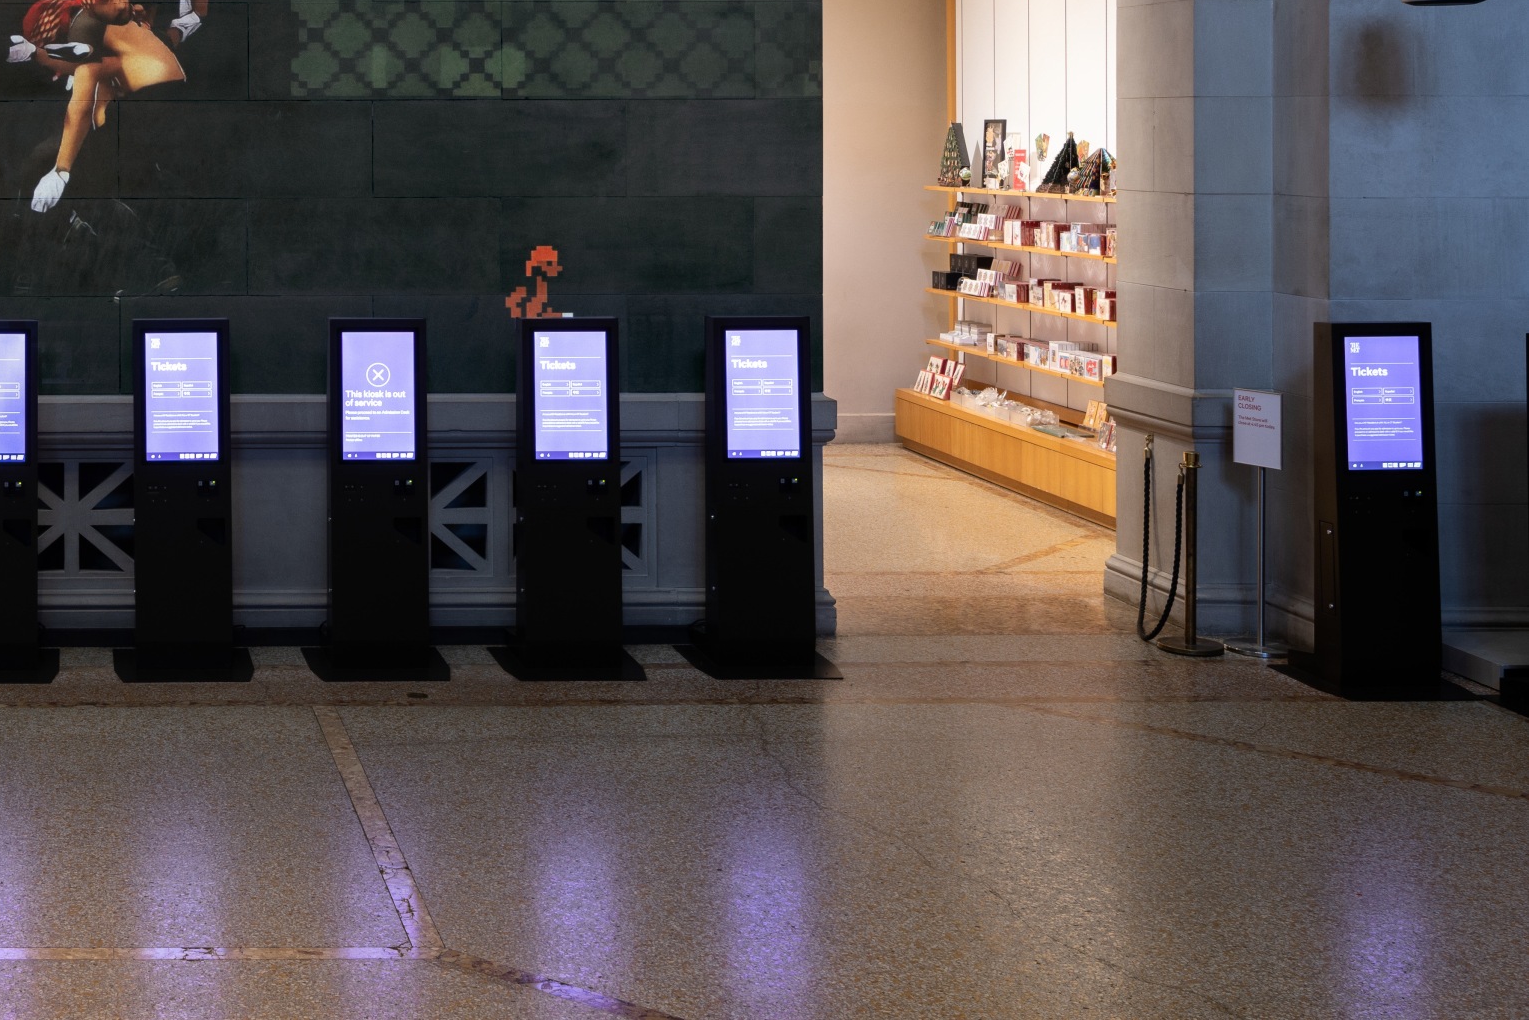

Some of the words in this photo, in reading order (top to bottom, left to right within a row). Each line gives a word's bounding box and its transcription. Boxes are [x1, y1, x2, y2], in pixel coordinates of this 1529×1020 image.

[150, 362, 187, 371] Tickets
[539, 360, 576, 370] Tickets
[731, 359, 768, 368] Tickets
[1350, 367, 1388, 376] Tickets
[345, 390, 362, 398] This
[363, 390, 384, 398] kiosk
[385, 390, 391, 398] is
[393, 390, 406, 398] out
[1238, 394, 1255, 402] EARLY
[345, 398, 353, 406] of
[1238, 402, 1262, 412] CLOSING
